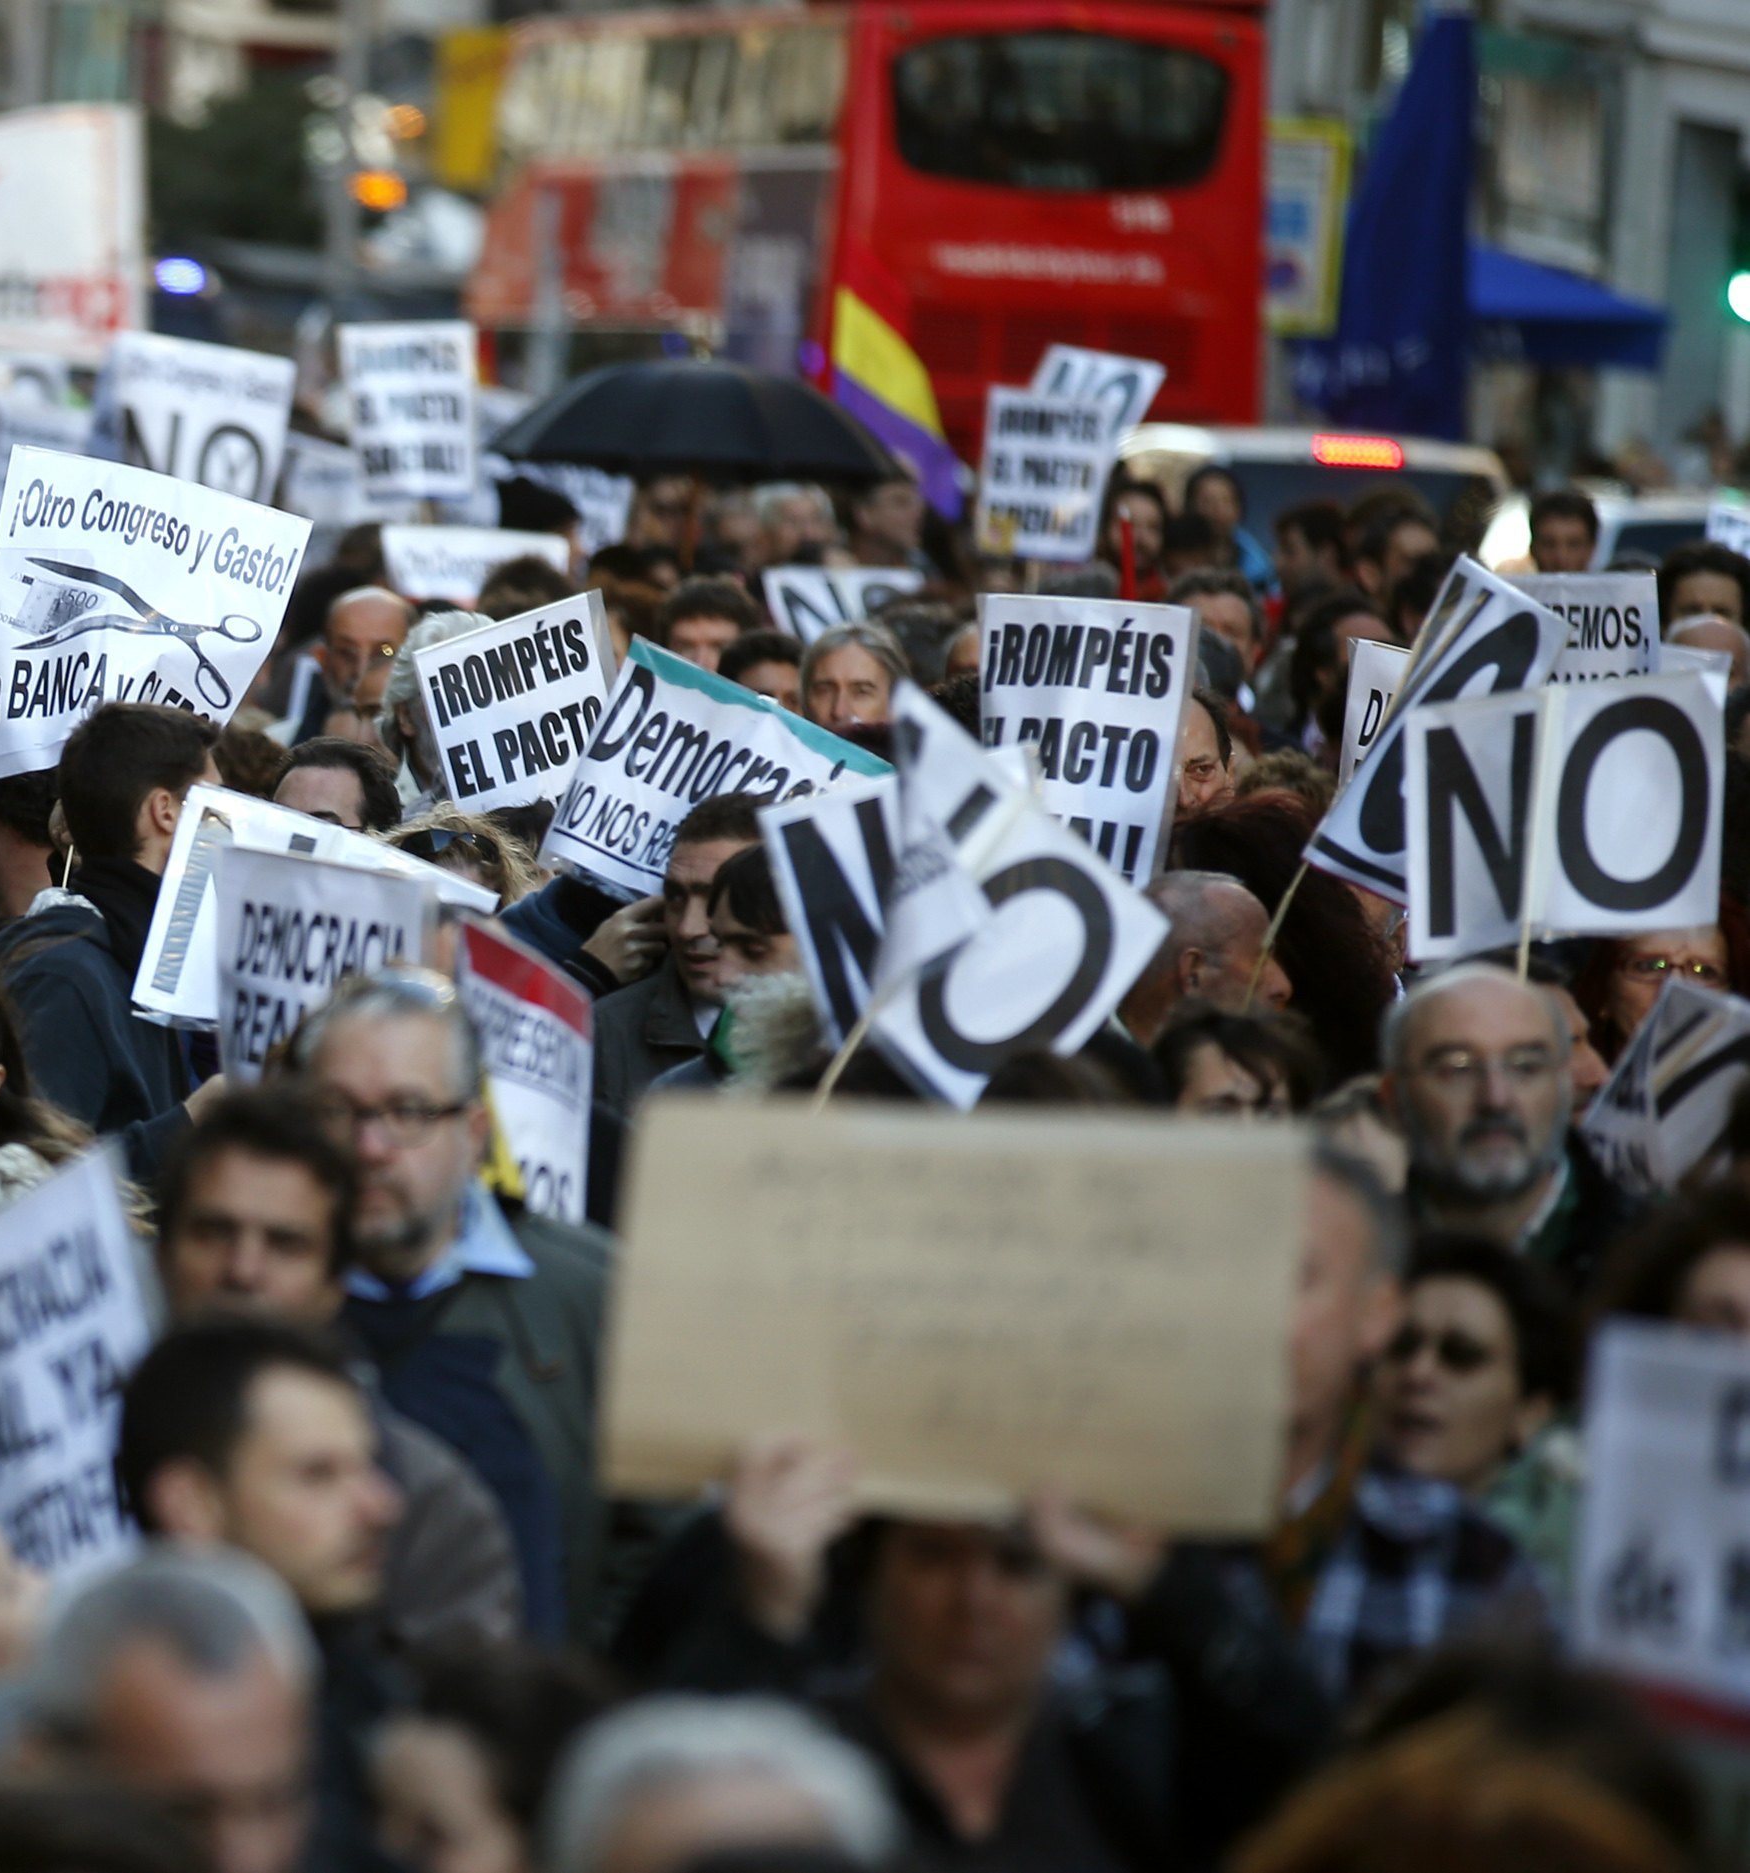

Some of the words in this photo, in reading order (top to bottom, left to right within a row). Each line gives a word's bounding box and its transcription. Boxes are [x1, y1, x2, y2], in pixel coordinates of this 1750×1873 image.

[9, 479, 75, 538] ¡Otro
[81, 489, 190, 546] Congreso
[188, 530, 214, 574] y
[213, 527, 298, 596] Gasto!
[7, 652, 108, 720] BANCA
[428, 619, 590, 727] ¡ROMPÉIS
[984, 617, 1175, 700] ¡ROMPÉIS
[447, 739, 495, 798] EL
[497, 694, 603, 783] PACTO
[1017, 717, 1161, 794] PACTO
[554, 778, 597, 829] NO
[587, 794, 649, 856] NOS
[638, 819, 680, 869] RE
[1425, 694, 1711, 940] NO
[234, 901, 405, 986] DEMOCRACIA
[780, 798, 1115, 1075] NO
[233, 986, 306, 1064] REA
